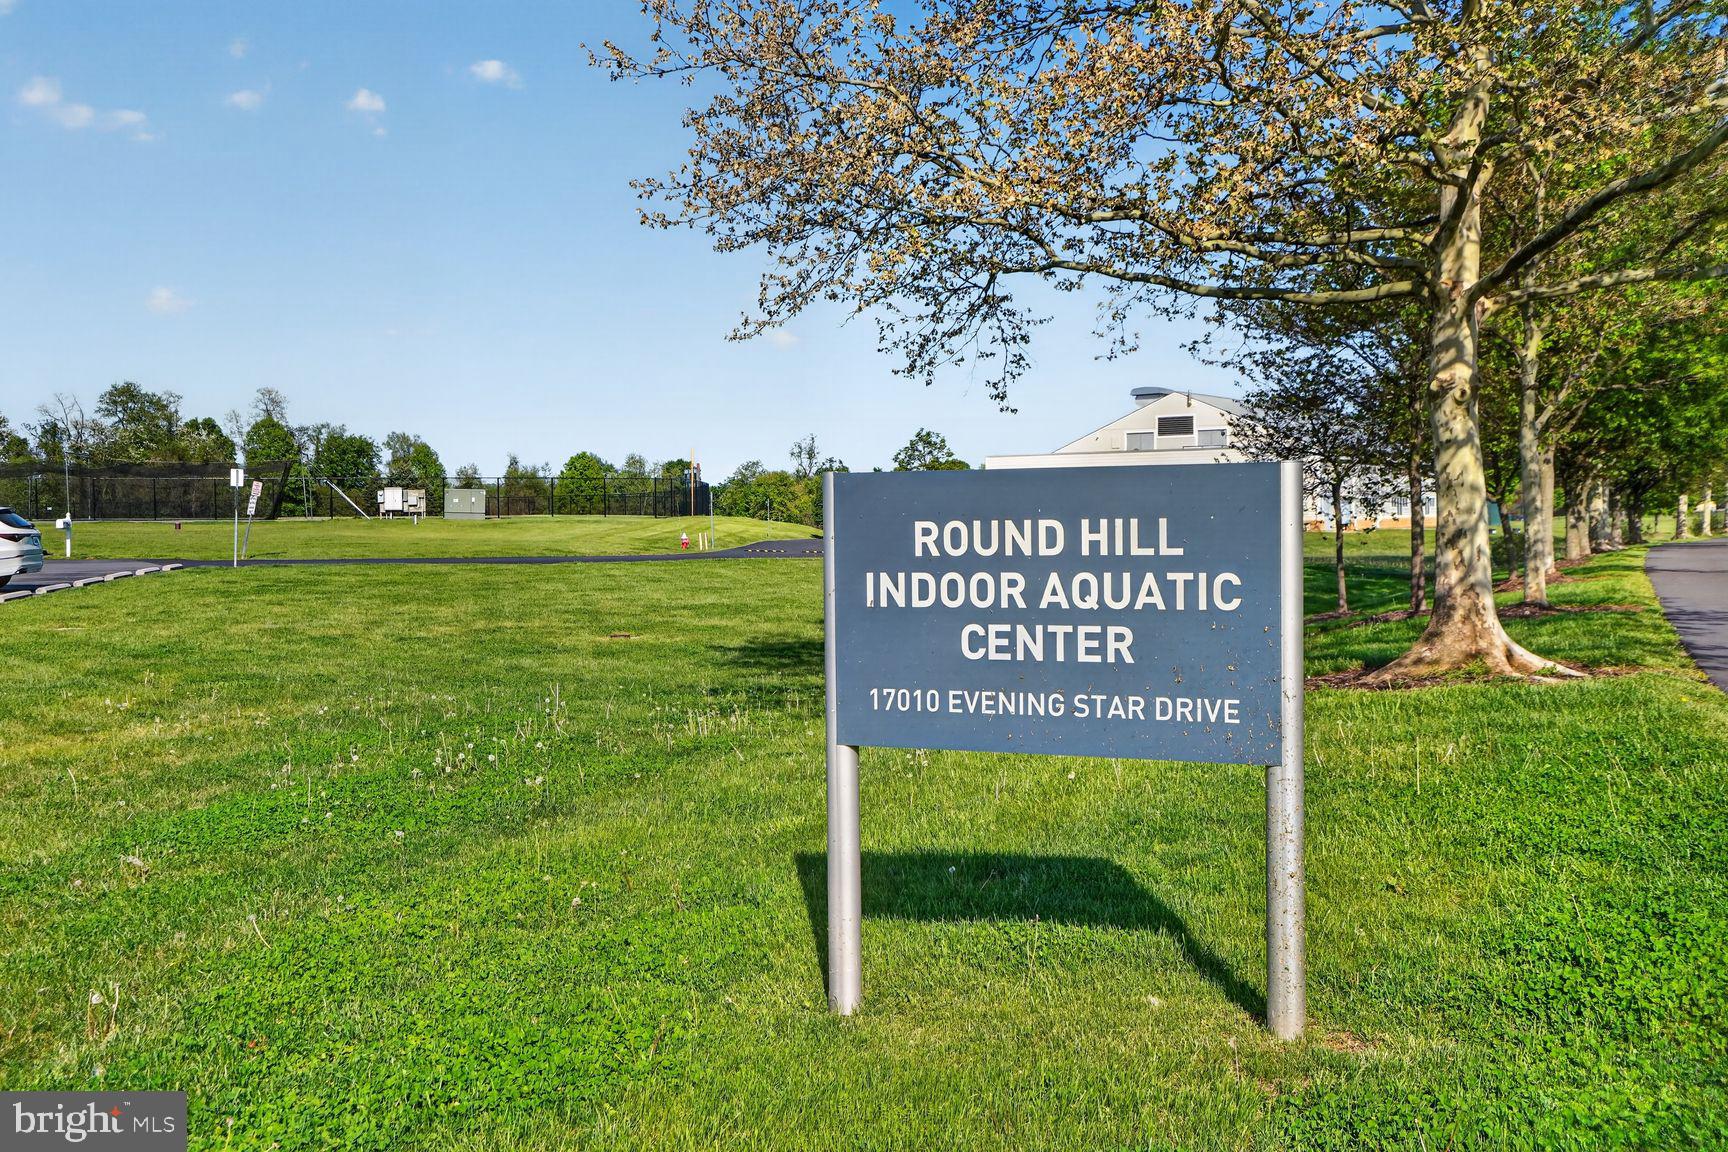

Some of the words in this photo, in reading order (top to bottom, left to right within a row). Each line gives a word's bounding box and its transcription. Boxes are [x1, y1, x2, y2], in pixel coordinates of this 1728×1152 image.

[914, 519, 1065, 557] ROUND
[1081, 517, 1184, 556] HILL
[866, 571, 1028, 609] INDOOR
[1038, 571, 1242, 611] AQUATIC
[960, 623, 1135, 664] CENTER
[869, 687, 939, 713] 17010
[948, 690, 1065, 717] EVENING
[1073, 694, 1146, 720] STAR
[1155, 696, 1241, 724] DRIVE
